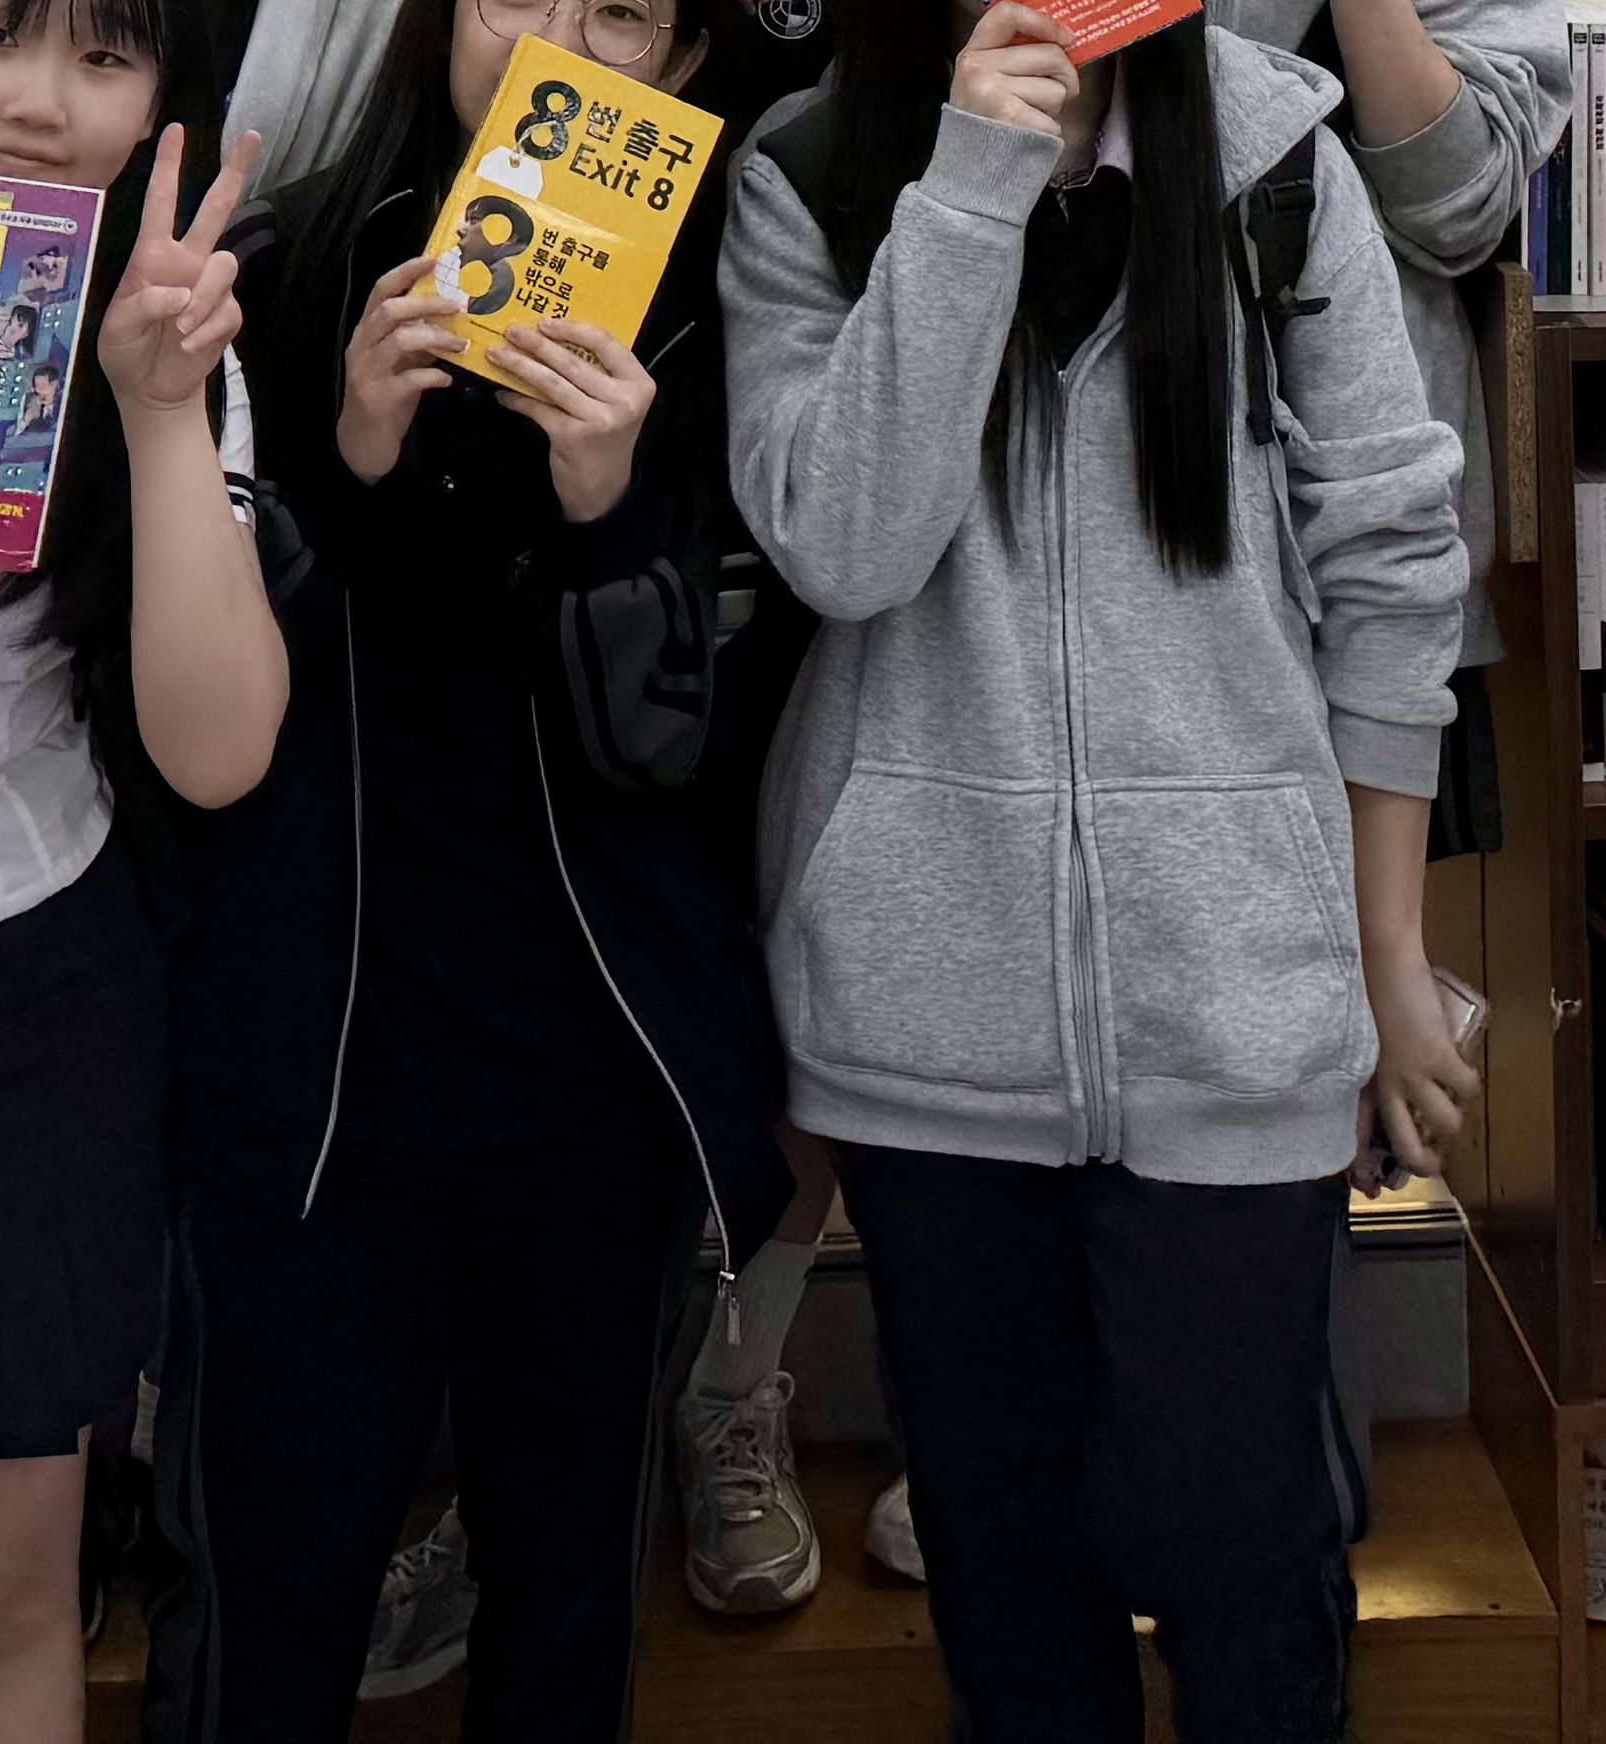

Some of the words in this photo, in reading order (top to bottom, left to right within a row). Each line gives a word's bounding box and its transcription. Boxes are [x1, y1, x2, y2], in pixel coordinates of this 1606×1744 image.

[622, 117, 695, 172] 출구
[568, 141, 642, 198] Exit
[646, 177, 675, 212] 8
[560, 236, 611, 272] 출구를
[515, 287, 550, 315] 나갈
[523, 266, 574, 302] 밖으로
